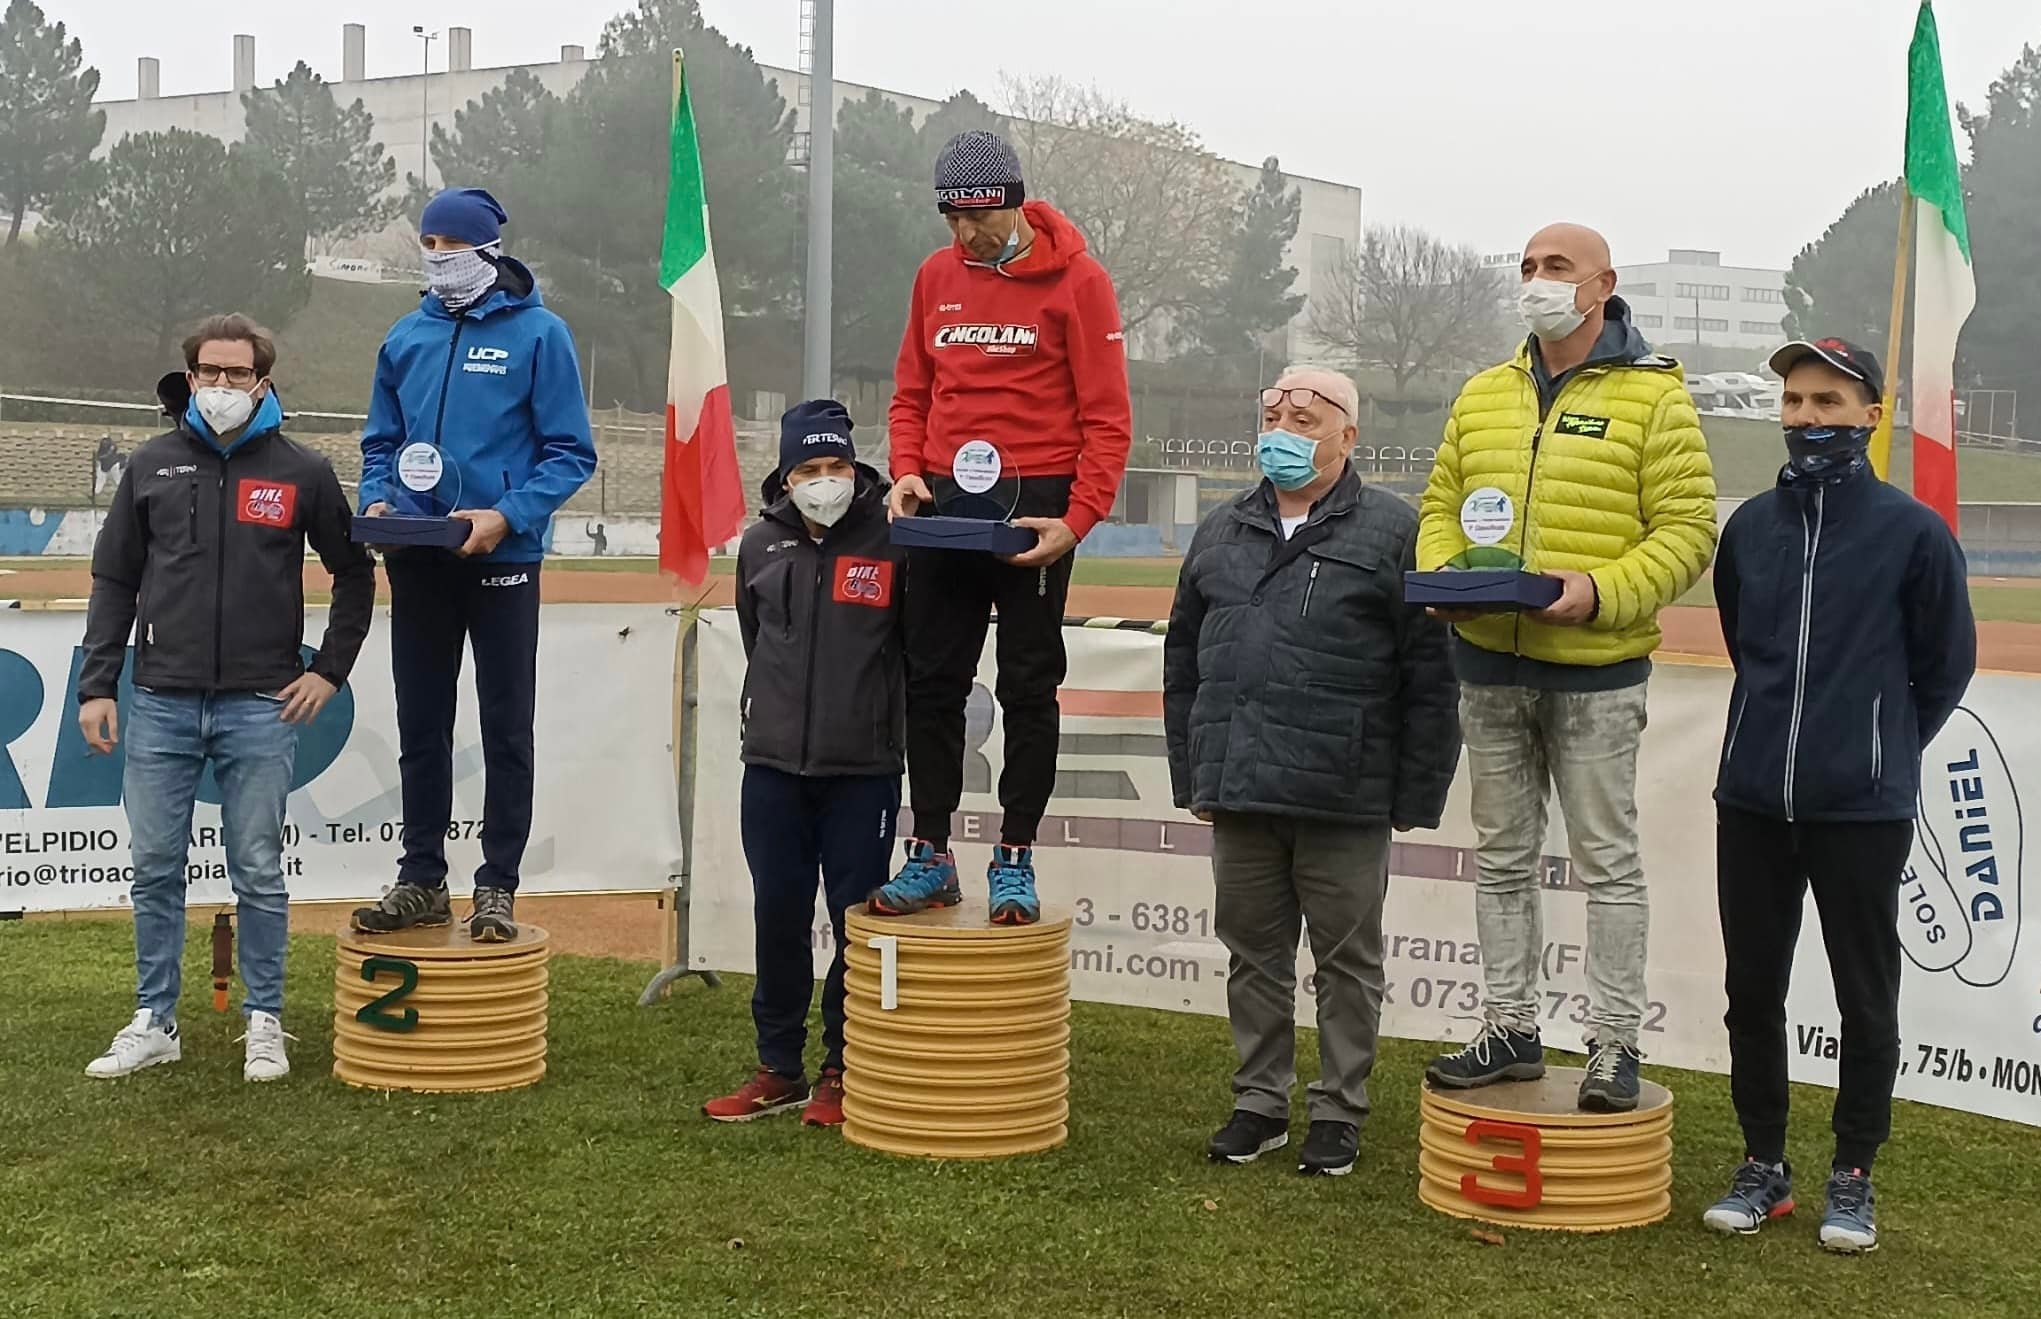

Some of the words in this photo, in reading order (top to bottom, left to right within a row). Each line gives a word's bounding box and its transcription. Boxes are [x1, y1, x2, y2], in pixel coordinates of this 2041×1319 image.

[937, 188, 1001, 200] GOLANI
[468, 346, 509, 361] UCP
[481, 572, 529, 587] LEGEA
[325, 822, 371, 843] Tel.
[1131, 902, 1209, 937] 6381
[867, 935, 898, 1010] 1
[1071, 945, 1200, 983] mi.com
[356, 955, 419, 1027] 2
[1796, 1024, 1840, 1060] Via
[1916, 1043, 1973, 1082] 75/b
[1461, 1120, 1543, 1208] 3
